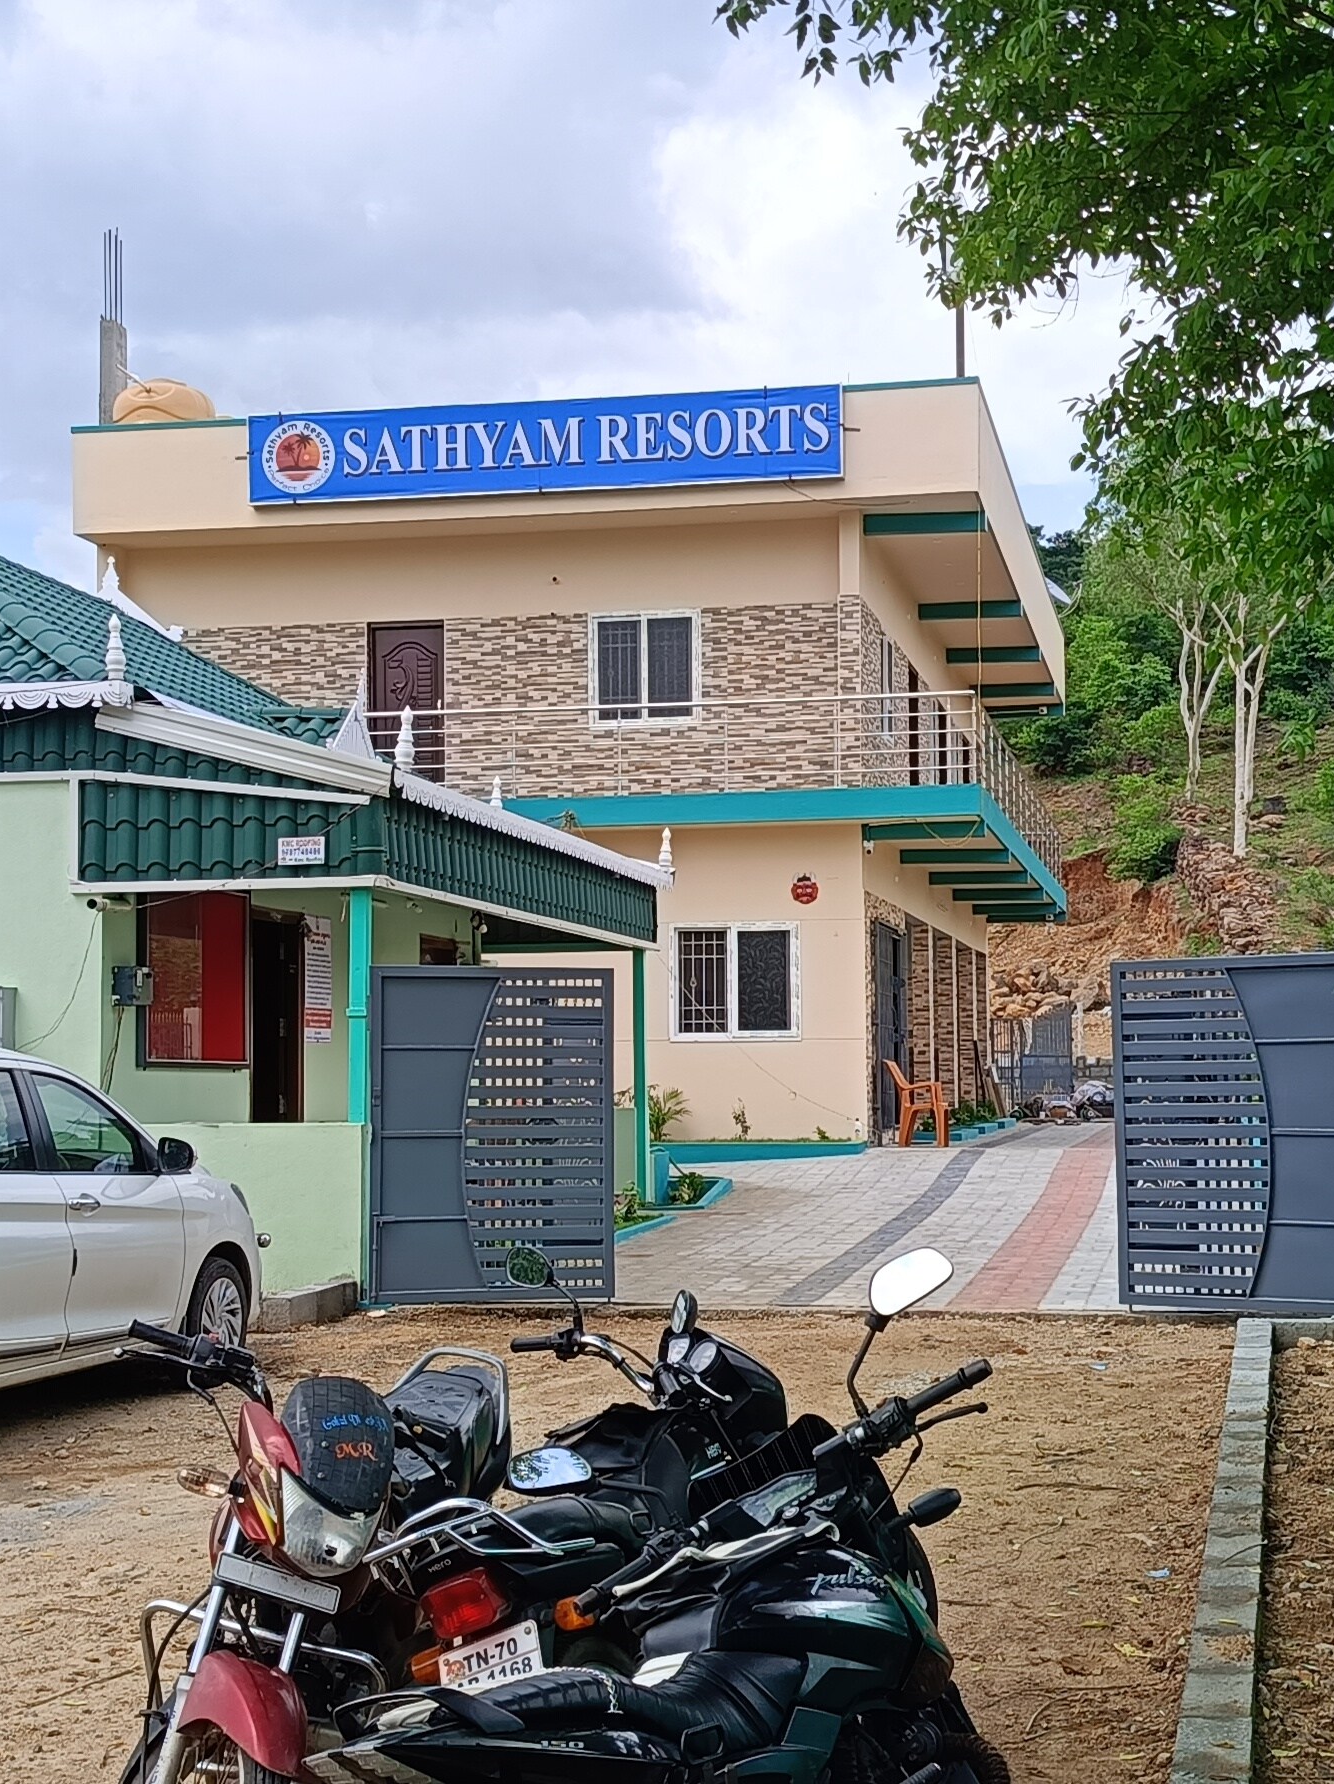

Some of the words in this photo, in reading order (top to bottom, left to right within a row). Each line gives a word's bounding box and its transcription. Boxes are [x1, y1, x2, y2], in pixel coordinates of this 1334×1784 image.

[265, 423, 298, 464] Sathyam
[303, 422, 330, 461] Resorts
[343, 417, 586, 478] SATHYAM
[596, 402, 831, 465] RESORTS
[427, 1558, 452, 1573] Hero
[462, 1637, 519, 1673] TN-70
